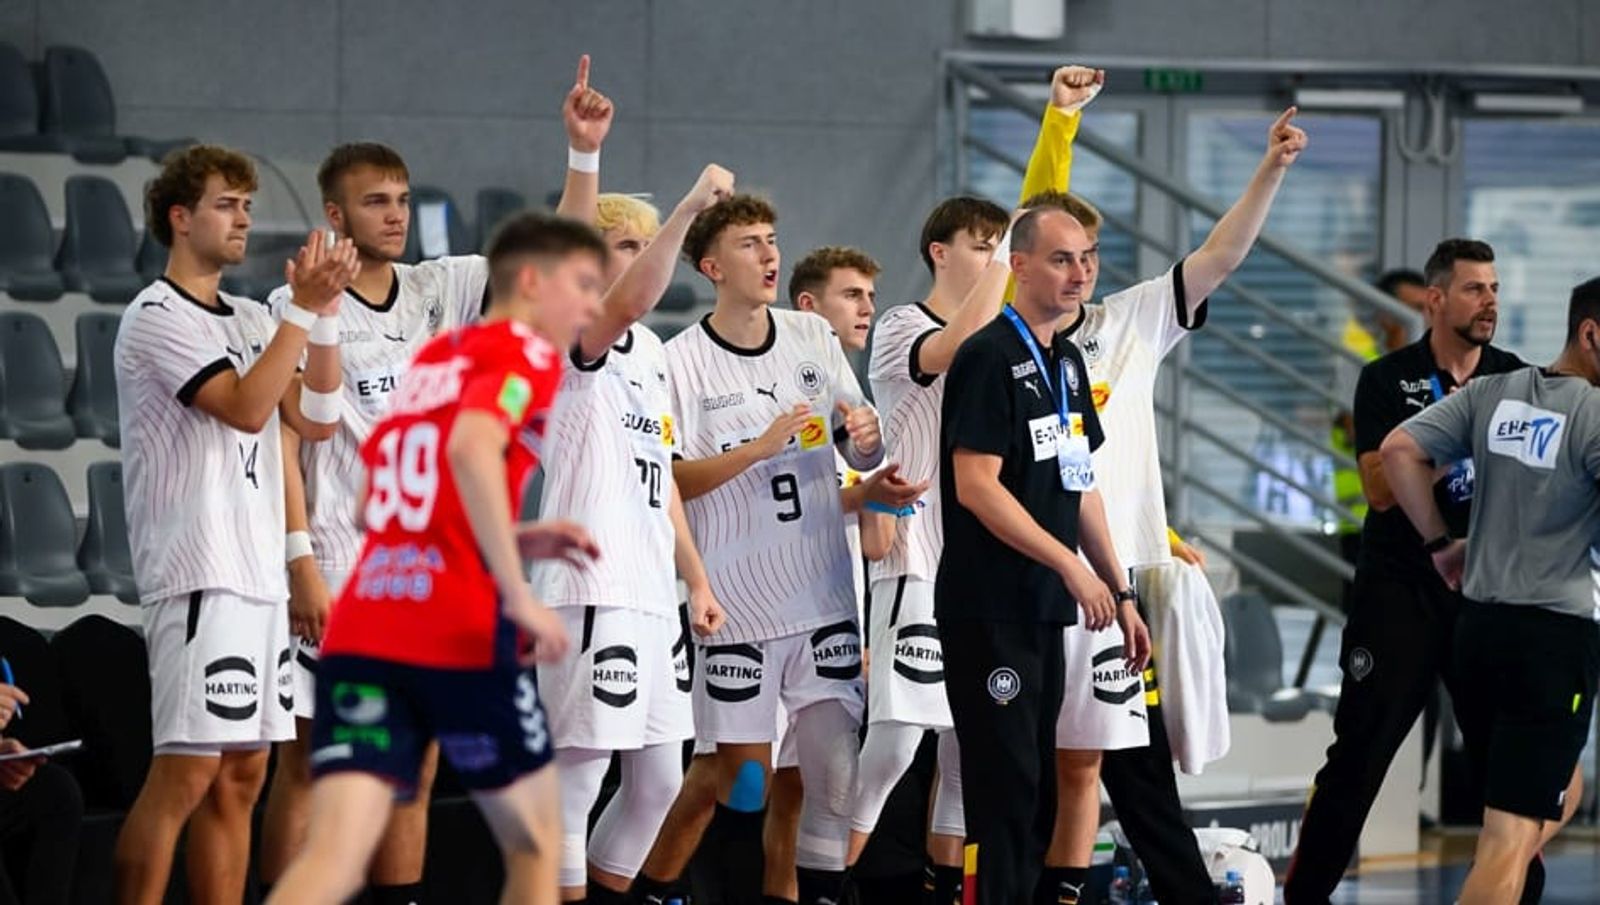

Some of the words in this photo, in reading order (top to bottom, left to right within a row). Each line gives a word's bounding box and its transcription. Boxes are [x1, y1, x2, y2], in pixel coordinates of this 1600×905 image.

[1529, 417, 1560, 460] TV
[366, 420, 441, 532] 39
[771, 472, 802, 523] 9
[205, 682, 257, 695] HARTING
[594, 669, 637, 684] HARTING
